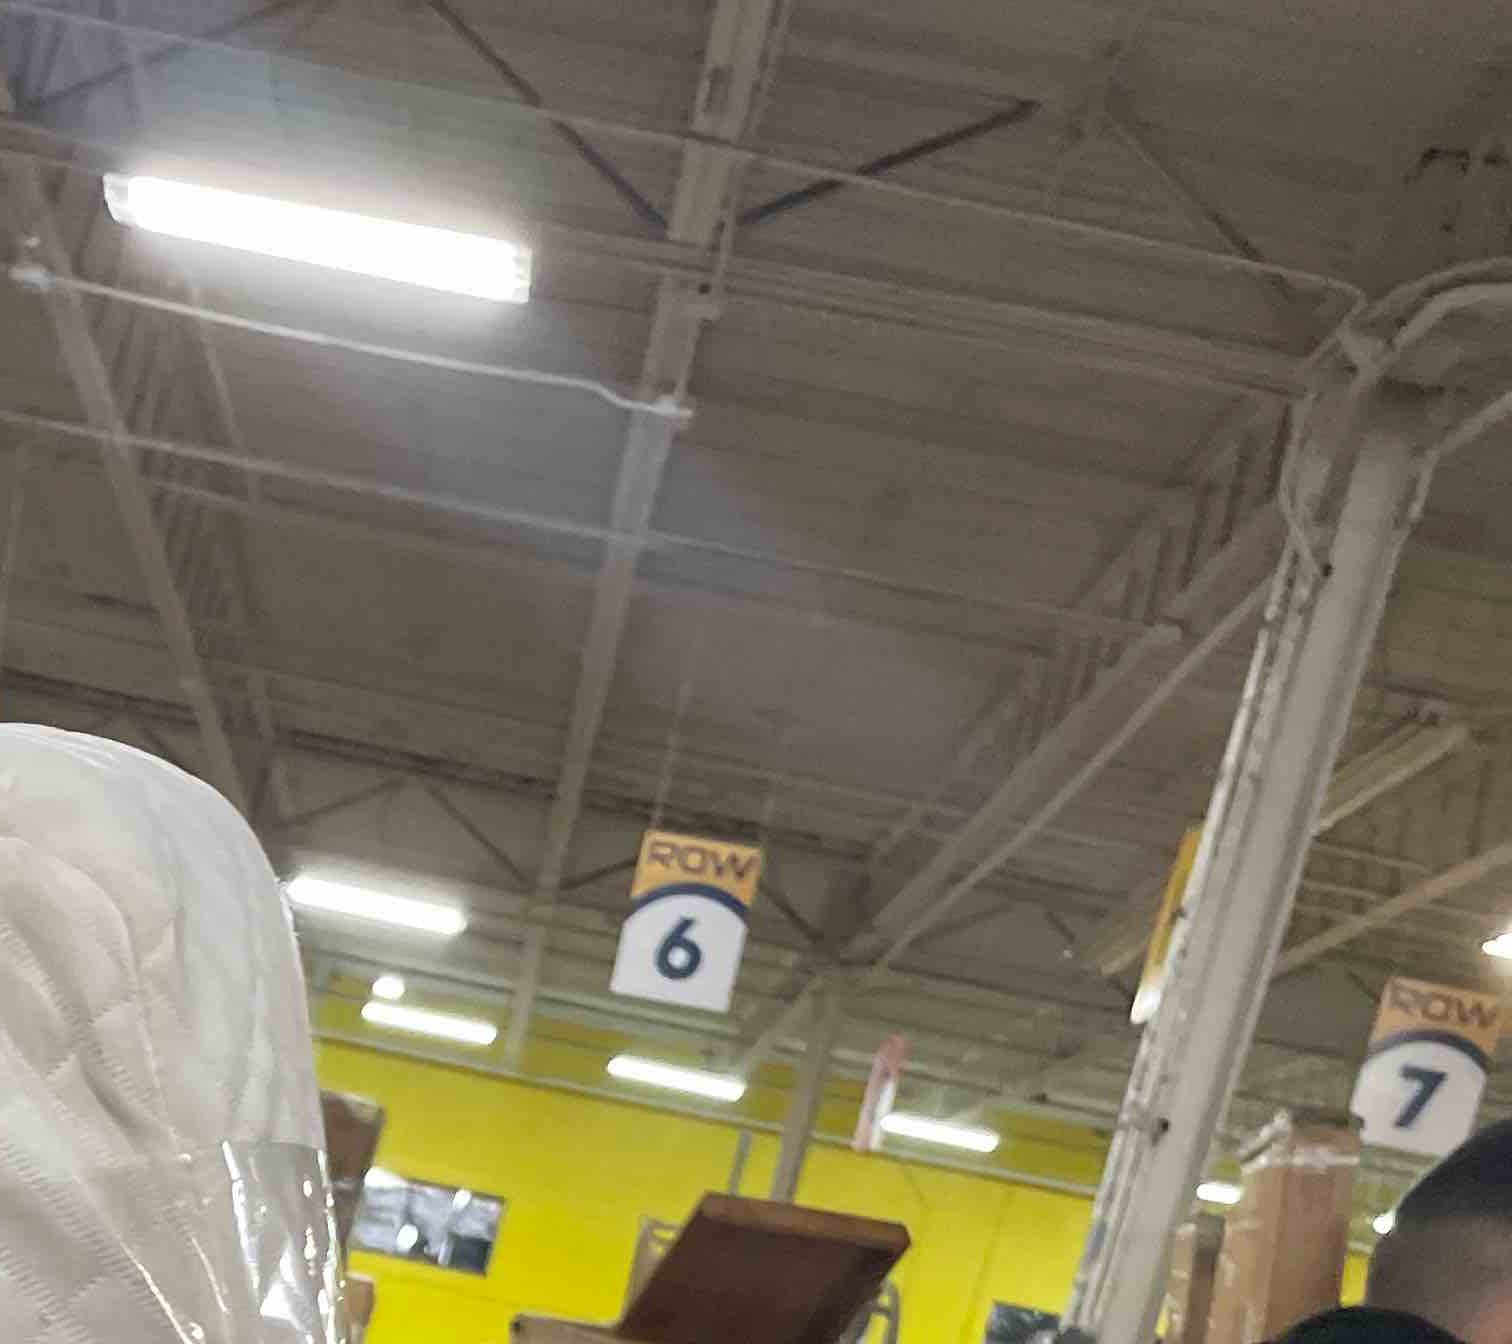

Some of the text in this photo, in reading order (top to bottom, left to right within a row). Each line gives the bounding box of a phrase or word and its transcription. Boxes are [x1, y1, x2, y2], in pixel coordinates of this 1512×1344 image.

[647, 840, 761, 880] ROW
[656, 915, 703, 982] 6
[1387, 982, 1498, 1030] ROW
[1395, 1065, 1448, 1130] 7
